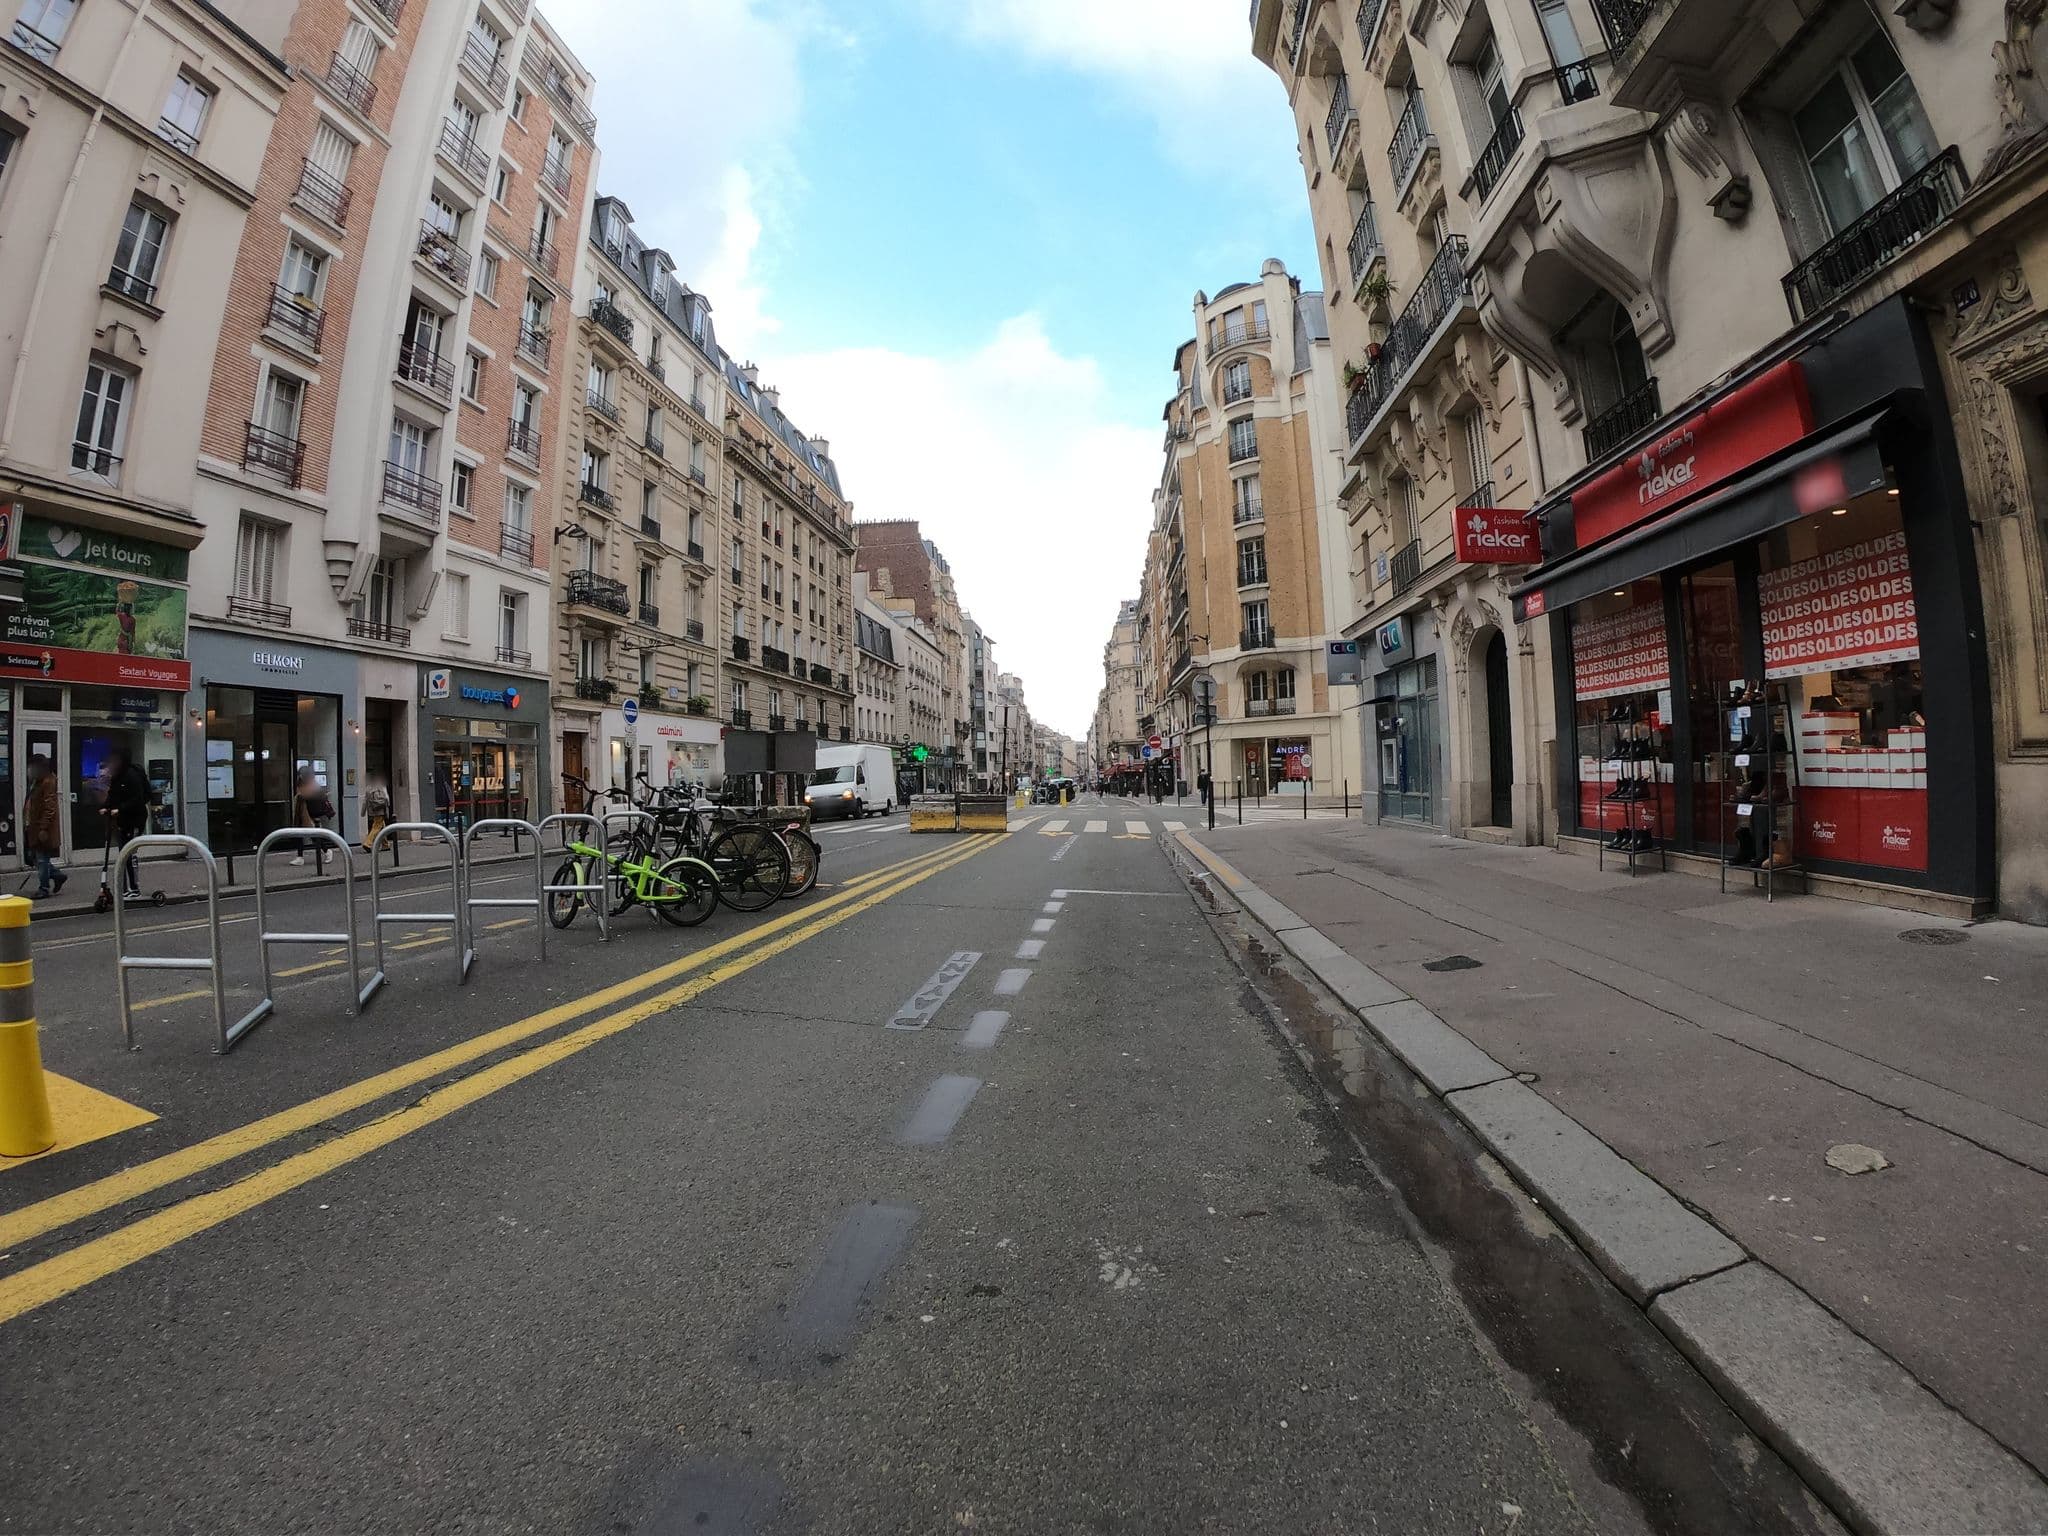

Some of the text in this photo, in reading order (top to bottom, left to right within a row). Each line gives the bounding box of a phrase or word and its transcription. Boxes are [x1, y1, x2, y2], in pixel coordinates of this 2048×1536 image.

[1639, 456, 1696, 504] rieker
[1466, 528, 1531, 548] rieker
[111, 542, 152, 567] tours
[8, 614, 50, 627] on rêvait
[7, 626, 28, 638] plus
[30, 627, 47, 639] loin
[1381, 627, 1399, 649] CIC
[1333, 643, 1354, 653] CIC
[253, 652, 305, 669] BELMONT
[119, 666, 178, 681] Sextant Voyages
[462, 685, 505, 703] bouygues
[1275, 744, 1305, 754] ANDRÉ
